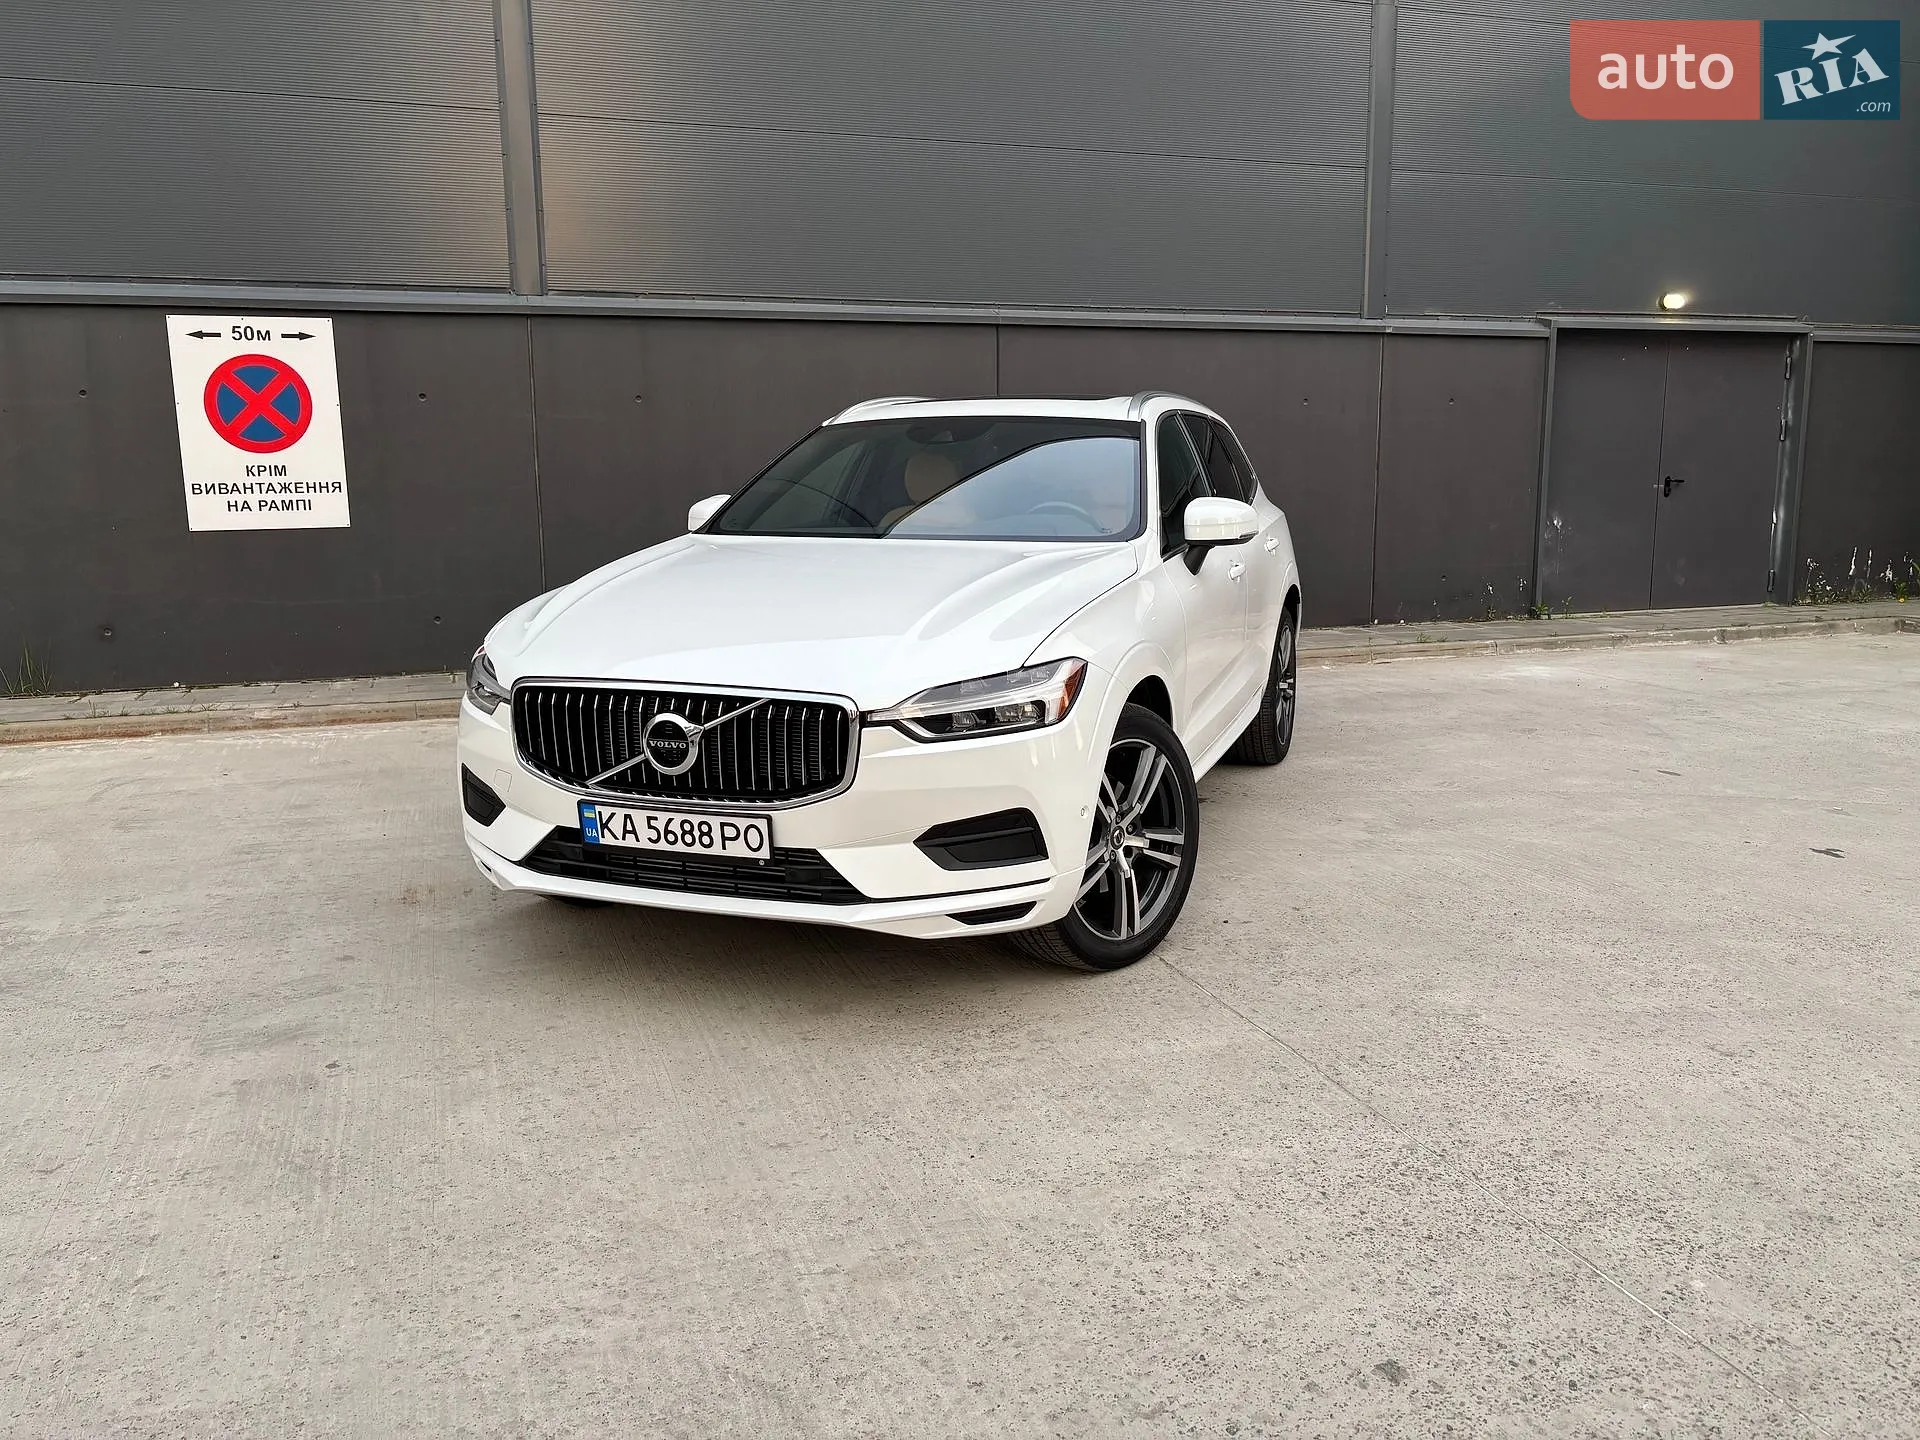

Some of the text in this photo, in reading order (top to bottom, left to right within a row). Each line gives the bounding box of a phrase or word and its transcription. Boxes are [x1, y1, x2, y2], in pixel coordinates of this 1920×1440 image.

[245, 464, 287, 477] КРІМ
[191, 481, 342, 495] ВИВАНТАЖЕННЯ
[227, 499, 312, 512] НА РАМПІ
[649, 740, 687, 749] VOLVO
[585, 827, 598, 837] UA
[597, 810, 764, 852] KA 5688 PO
